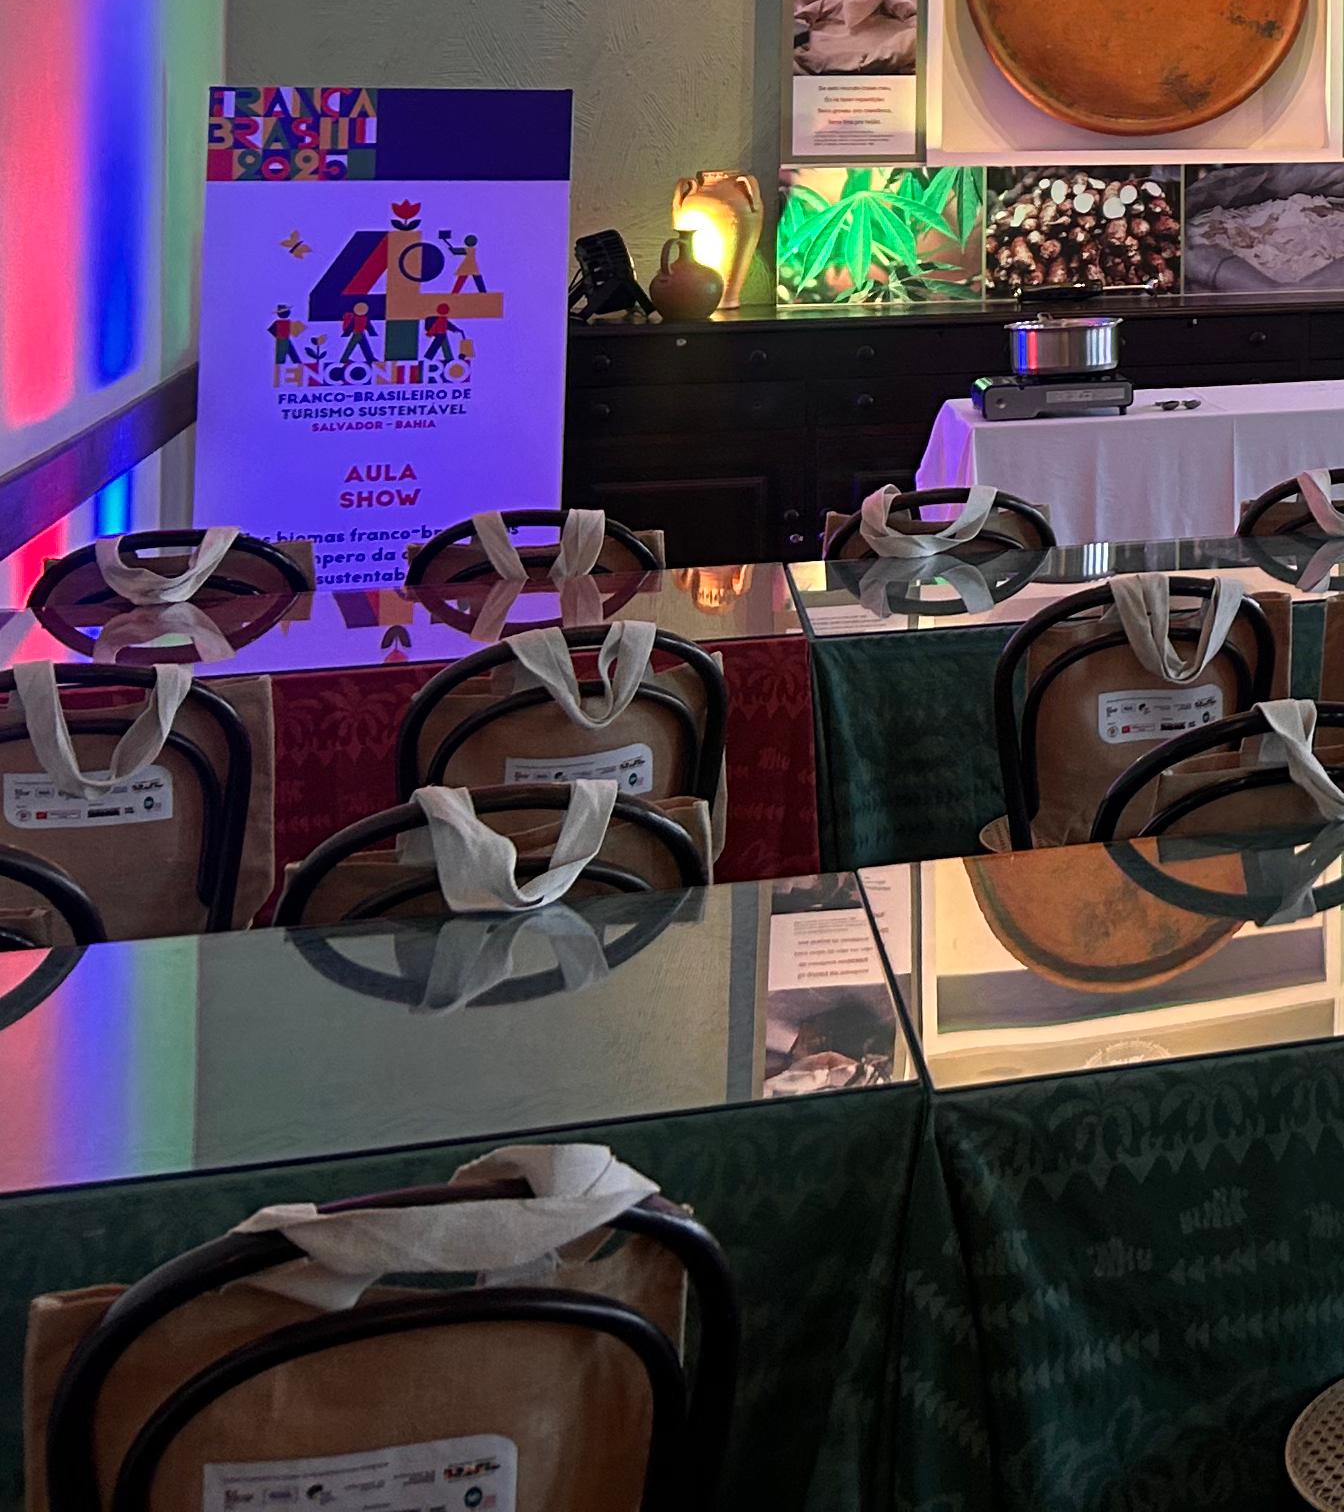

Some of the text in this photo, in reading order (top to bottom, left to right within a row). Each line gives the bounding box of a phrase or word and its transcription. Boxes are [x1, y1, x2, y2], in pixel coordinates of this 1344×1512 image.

[208, 117, 377, 149] BRASIL
[236, 149, 349, 181] 2025
[276, 359, 471, 387] ENCONTRO
[278, 389, 472, 405] FRANCO-BRASILEIRO DE
[281, 402, 467, 419] TURISMO SUSTENTÁVEL
[311, 421, 383, 432] SALVADOR
[395, 420, 436, 429] BAHIA
[345, 463, 418, 483] AULA
[339, 488, 422, 509] SHOW
[372, 547, 396, 561] da
[316, 567, 405, 585] sustentab
